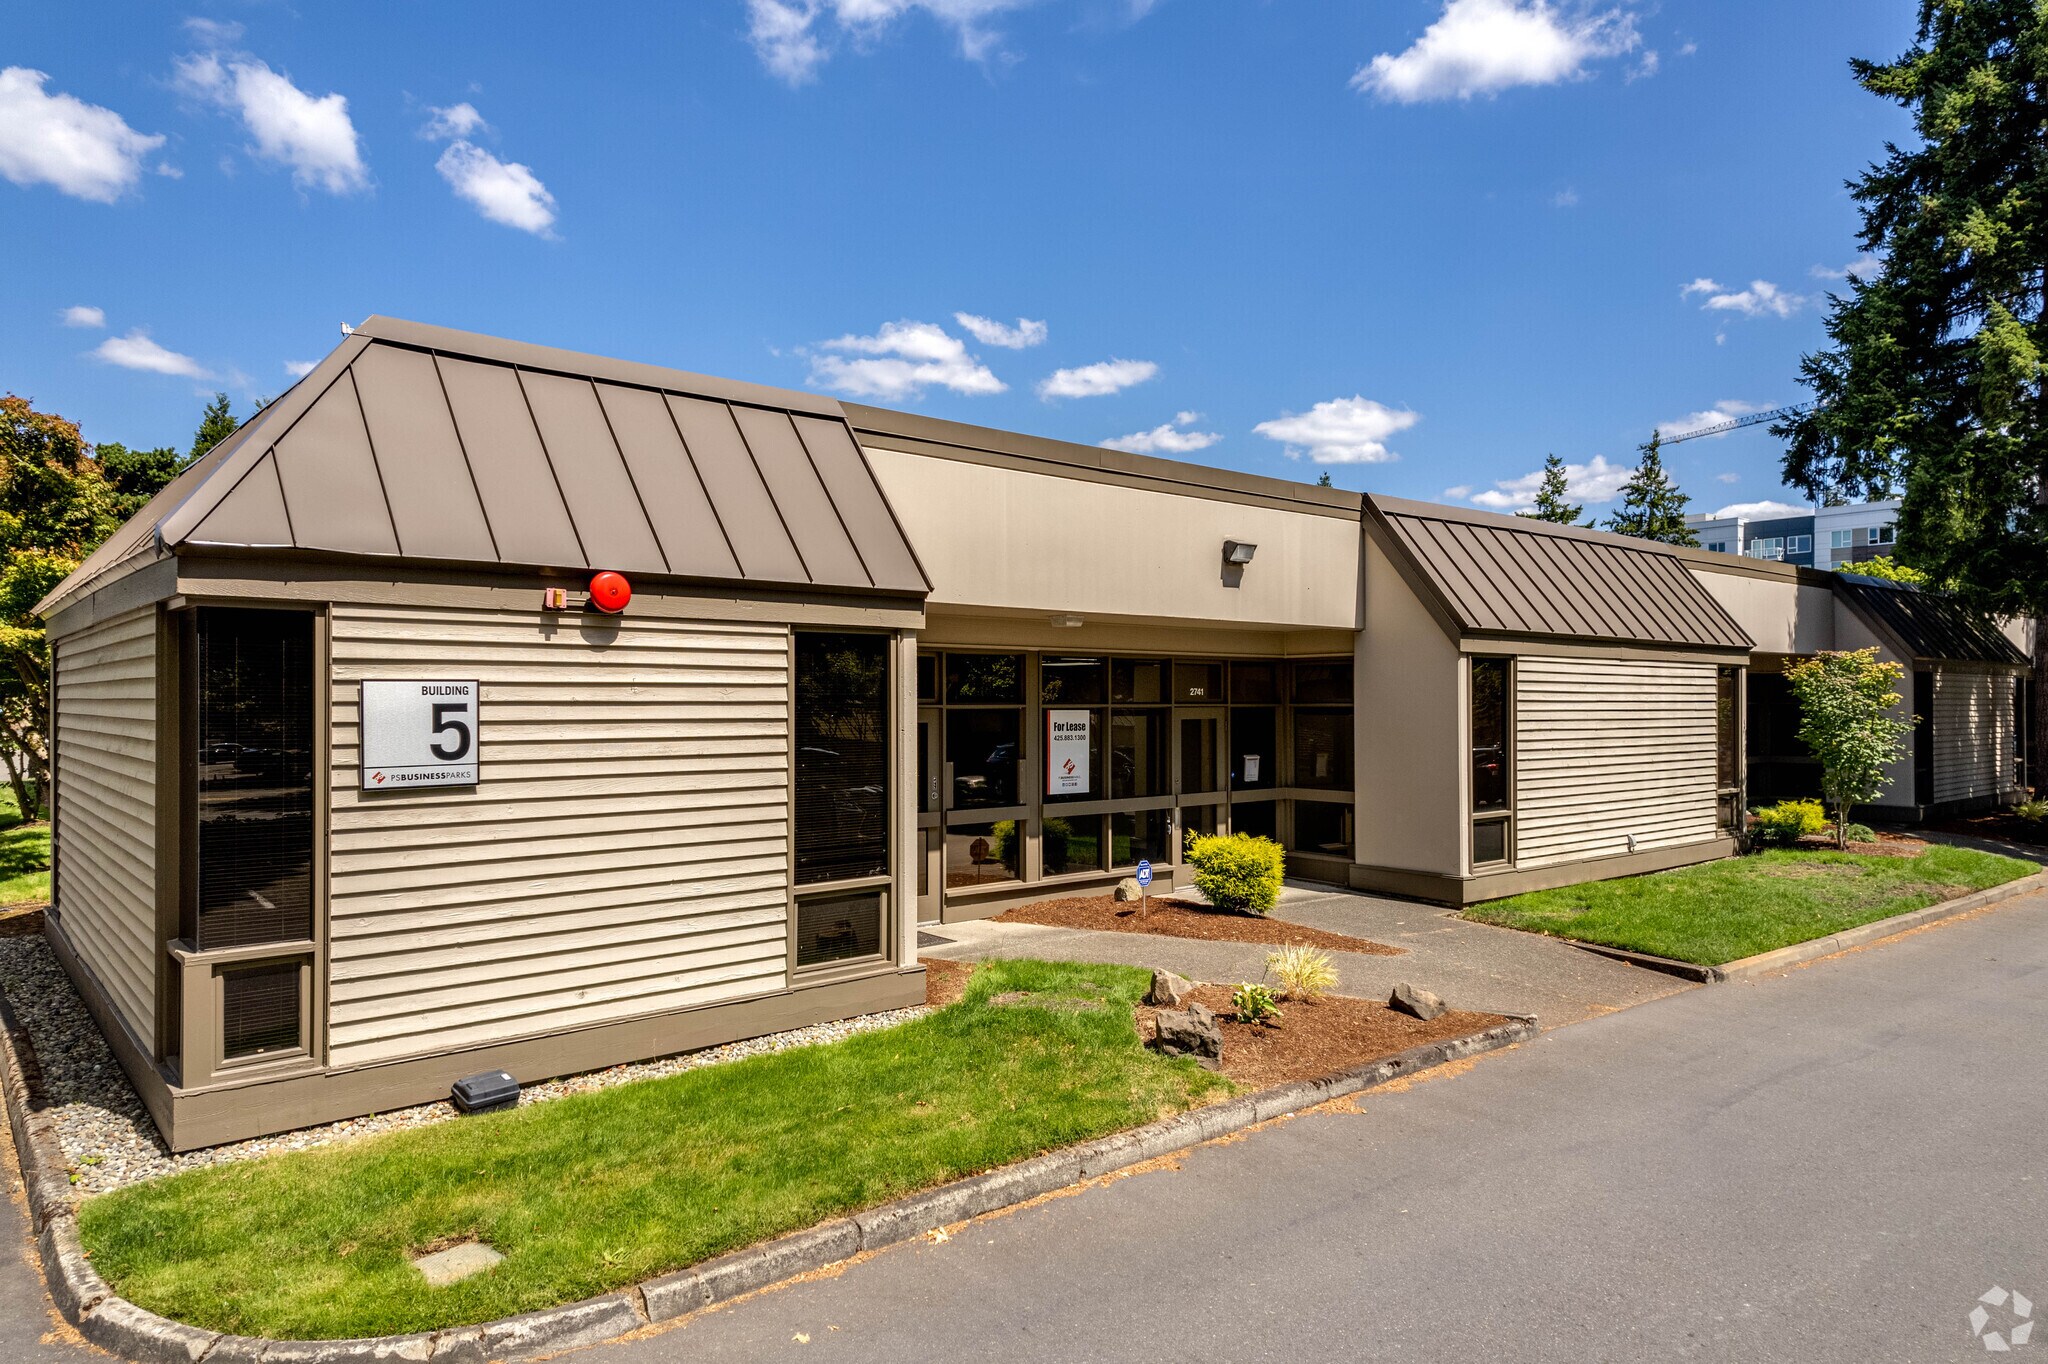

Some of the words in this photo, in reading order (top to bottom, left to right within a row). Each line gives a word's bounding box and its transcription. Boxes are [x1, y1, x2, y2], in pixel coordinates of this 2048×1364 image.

[421, 685, 469, 696] BUILDING
[1189, 687, 1204, 696] 2741
[429, 703, 471, 761] 5
[1053, 722, 1065, 732] For
[1065, 722, 1087, 732] Lease
[1053, 734, 1087, 742] 425.883.1300
[1139, 868, 1150, 879] ADT
